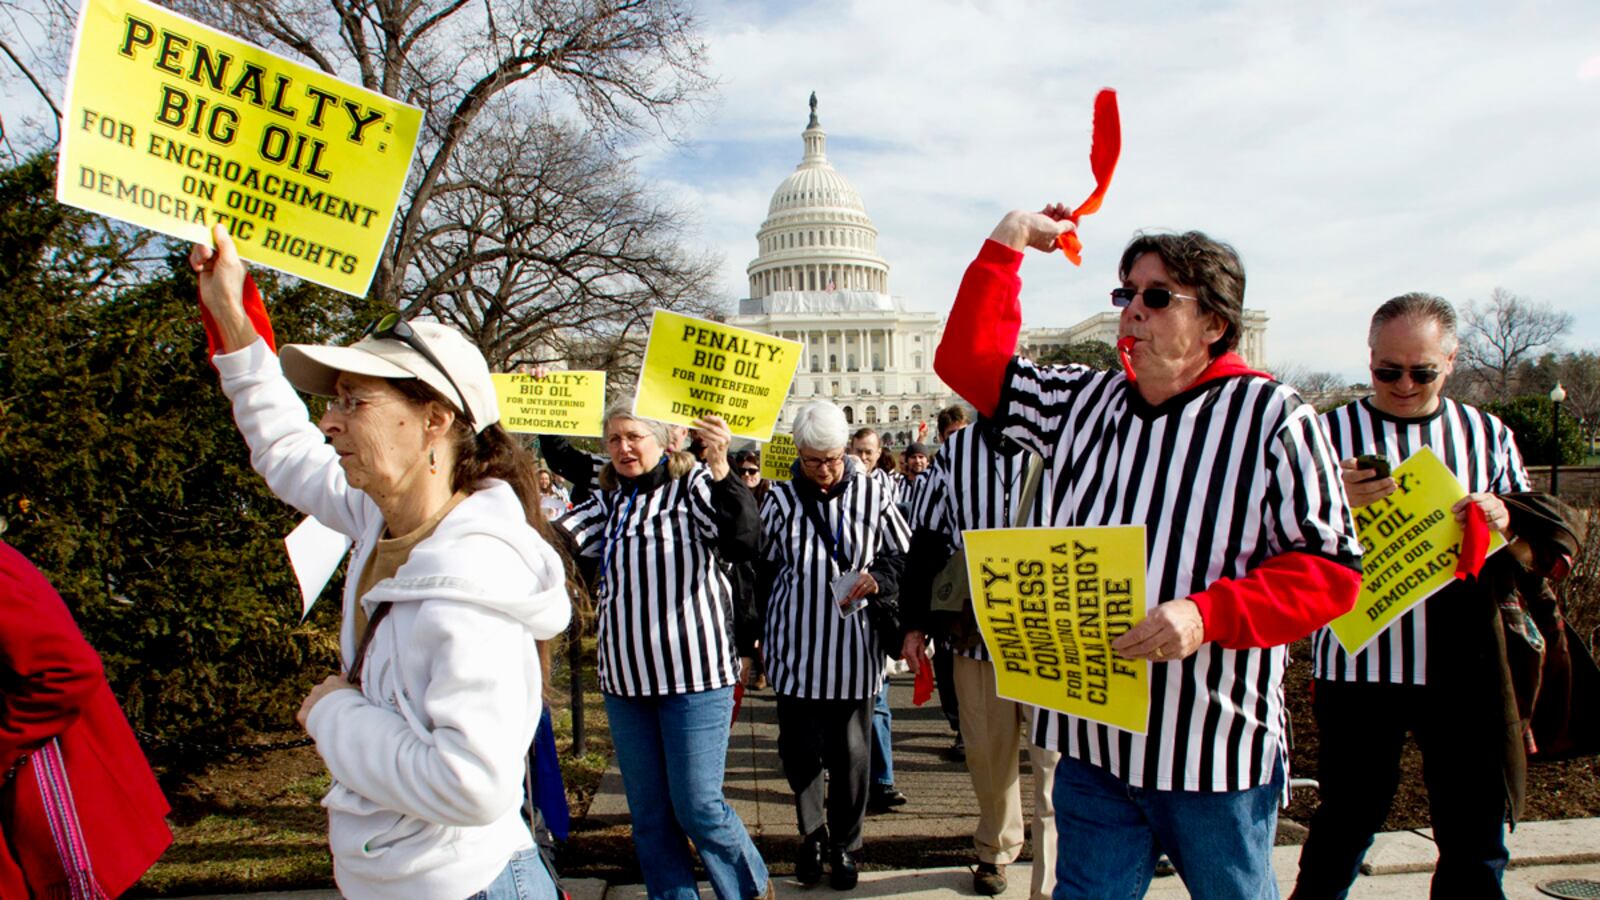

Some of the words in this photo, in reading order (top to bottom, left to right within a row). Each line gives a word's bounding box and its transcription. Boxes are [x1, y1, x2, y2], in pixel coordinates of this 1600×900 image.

[118, 13, 392, 152] PENALTY:
[155, 82, 241, 147] BIG
[258, 122, 332, 183] OIL
[82, 108, 135, 148] FOR
[148, 133, 379, 229] ENCROACHMENT
[182, 175, 216, 201] ON
[227, 190, 278, 222] OUR
[262, 227, 358, 275] RIGHTS
[682, 325, 784, 363] PENALTY:
[692, 350, 726, 371] BIG
[734, 359, 760, 380] OIL
[520, 385, 543, 395] BIG
[549, 386, 572, 397] OIL
[527, 398, 585, 408] INTERFERING
[672, 368, 695, 383] FOR
[700, 374, 770, 397] INTERFERING
[689, 387, 725, 404] WITH
[728, 397, 749, 409] OUR
[509, 417, 579, 429] DEMOCRACY
[520, 407, 546, 415] WITH
[1365, 508, 1446, 576] INTERFERING
[1377, 508, 1415, 537] OIL
[1050, 542, 1068, 555] A
[1366, 561, 1403, 594] WITH
[1404, 540, 1434, 563] OUR
[1052, 562, 1071, 612] BACK
[1073, 541, 1099, 640] ENERGY
[1366, 542, 1461, 621] DEMOCRACY
[980, 557, 1032, 676] PENALTY:
[1015, 559, 1064, 682] CONGRESS
[1103, 578, 1137, 680] FURE
[1067, 670, 1082, 700] FOR
[1082, 642, 1108, 706] CLEAN
